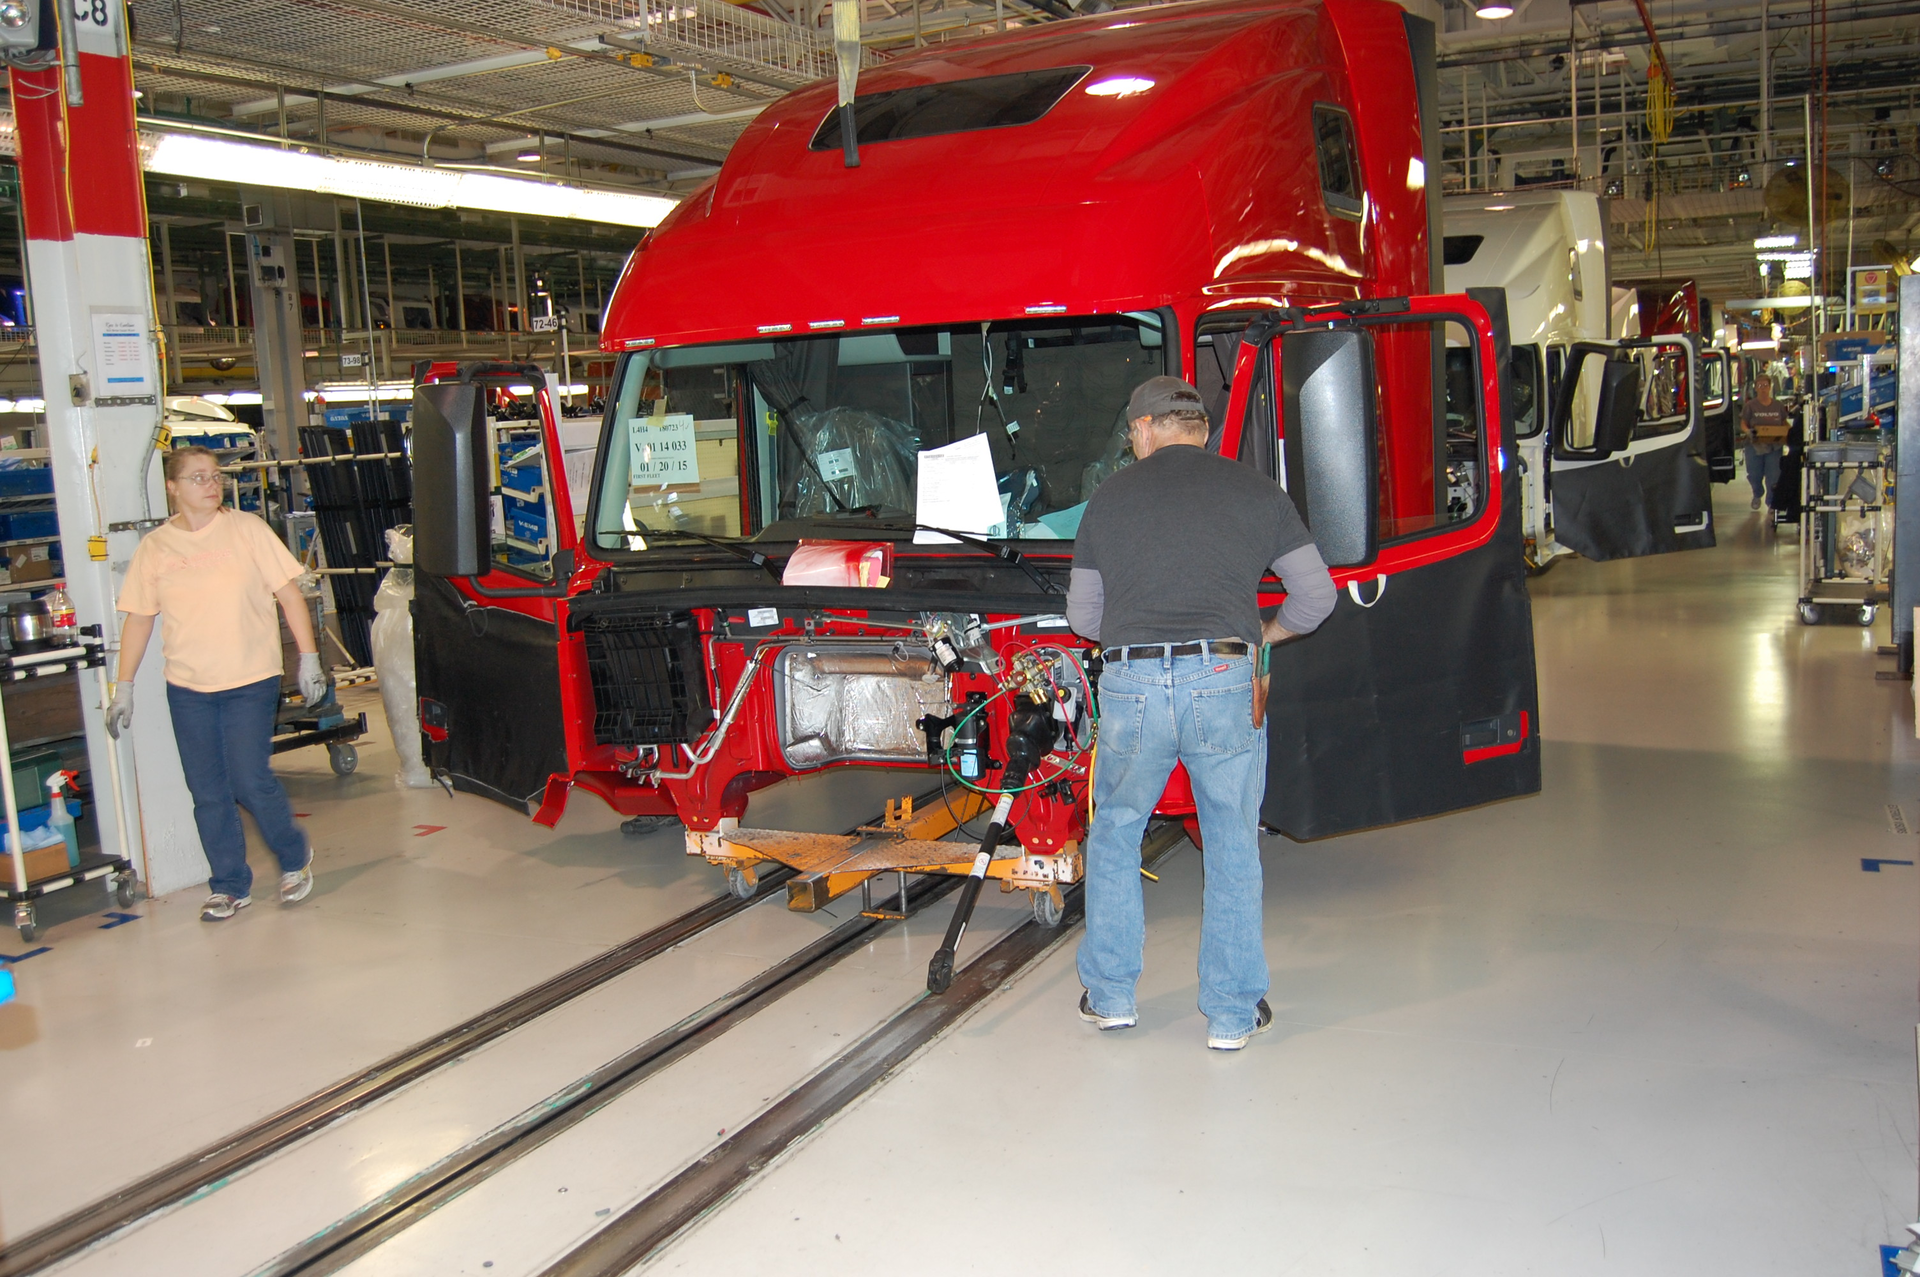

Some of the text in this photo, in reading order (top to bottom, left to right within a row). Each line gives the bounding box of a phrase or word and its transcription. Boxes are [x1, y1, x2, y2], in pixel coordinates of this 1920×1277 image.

[534, 318, 557, 329] 72-46
[343, 356, 360, 365] 73-98
[660, 442, 669, 452] 14
[672, 441, 687, 451] 033
[640, 463, 649, 472] 01
[659, 462, 668, 471] 20
[678, 461, 688, 470] 15
[518, 520, 538, 530] V-EMB
